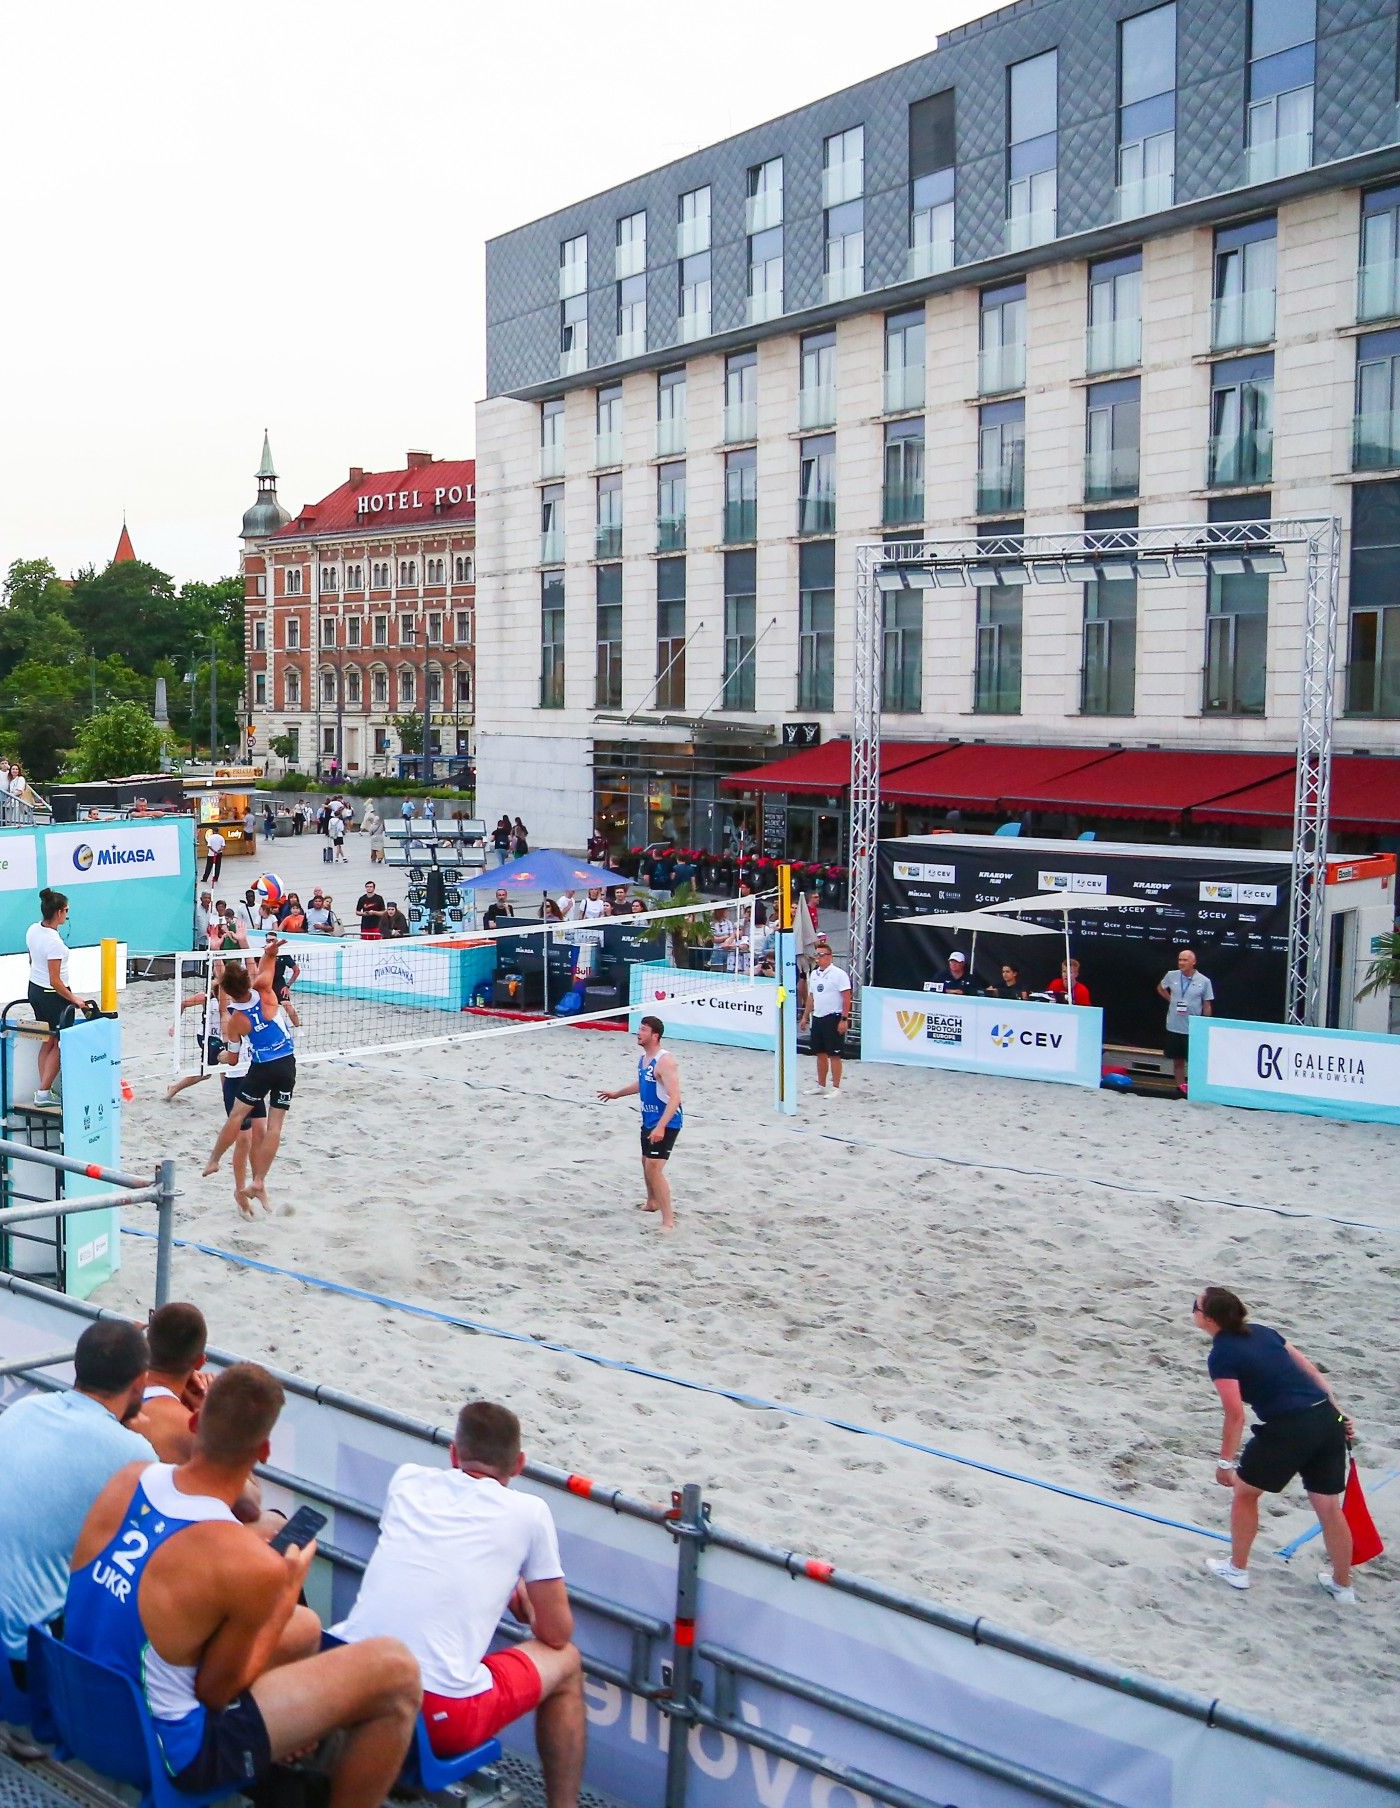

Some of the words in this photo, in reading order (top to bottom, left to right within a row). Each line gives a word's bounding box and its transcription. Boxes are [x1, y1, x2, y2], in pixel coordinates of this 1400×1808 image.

[357, 490, 423, 514] HOTEL
[978, 871, 1014, 880] KRAKOW
[1132, 881, 1172, 890] KRAKOW
[709, 997, 764, 1016] Catering
[926, 1015, 963, 1028] BEACH
[926, 1024, 942, 1033] PRO
[942, 1026, 963, 1034] TOUR
[932, 1033, 957, 1041] EUROPE
[1019, 1030, 1063, 1049] CEV
[1257, 1043, 1284, 1081] GK
[1294, 1052, 1366, 1076] GALERIA
[646, 1065, 654, 1077] 2
[1294, 1070, 1365, 1085] KRAKOWSKA
[111, 1529, 149, 1577] 2
[91, 1560, 132, 1604] UKR
